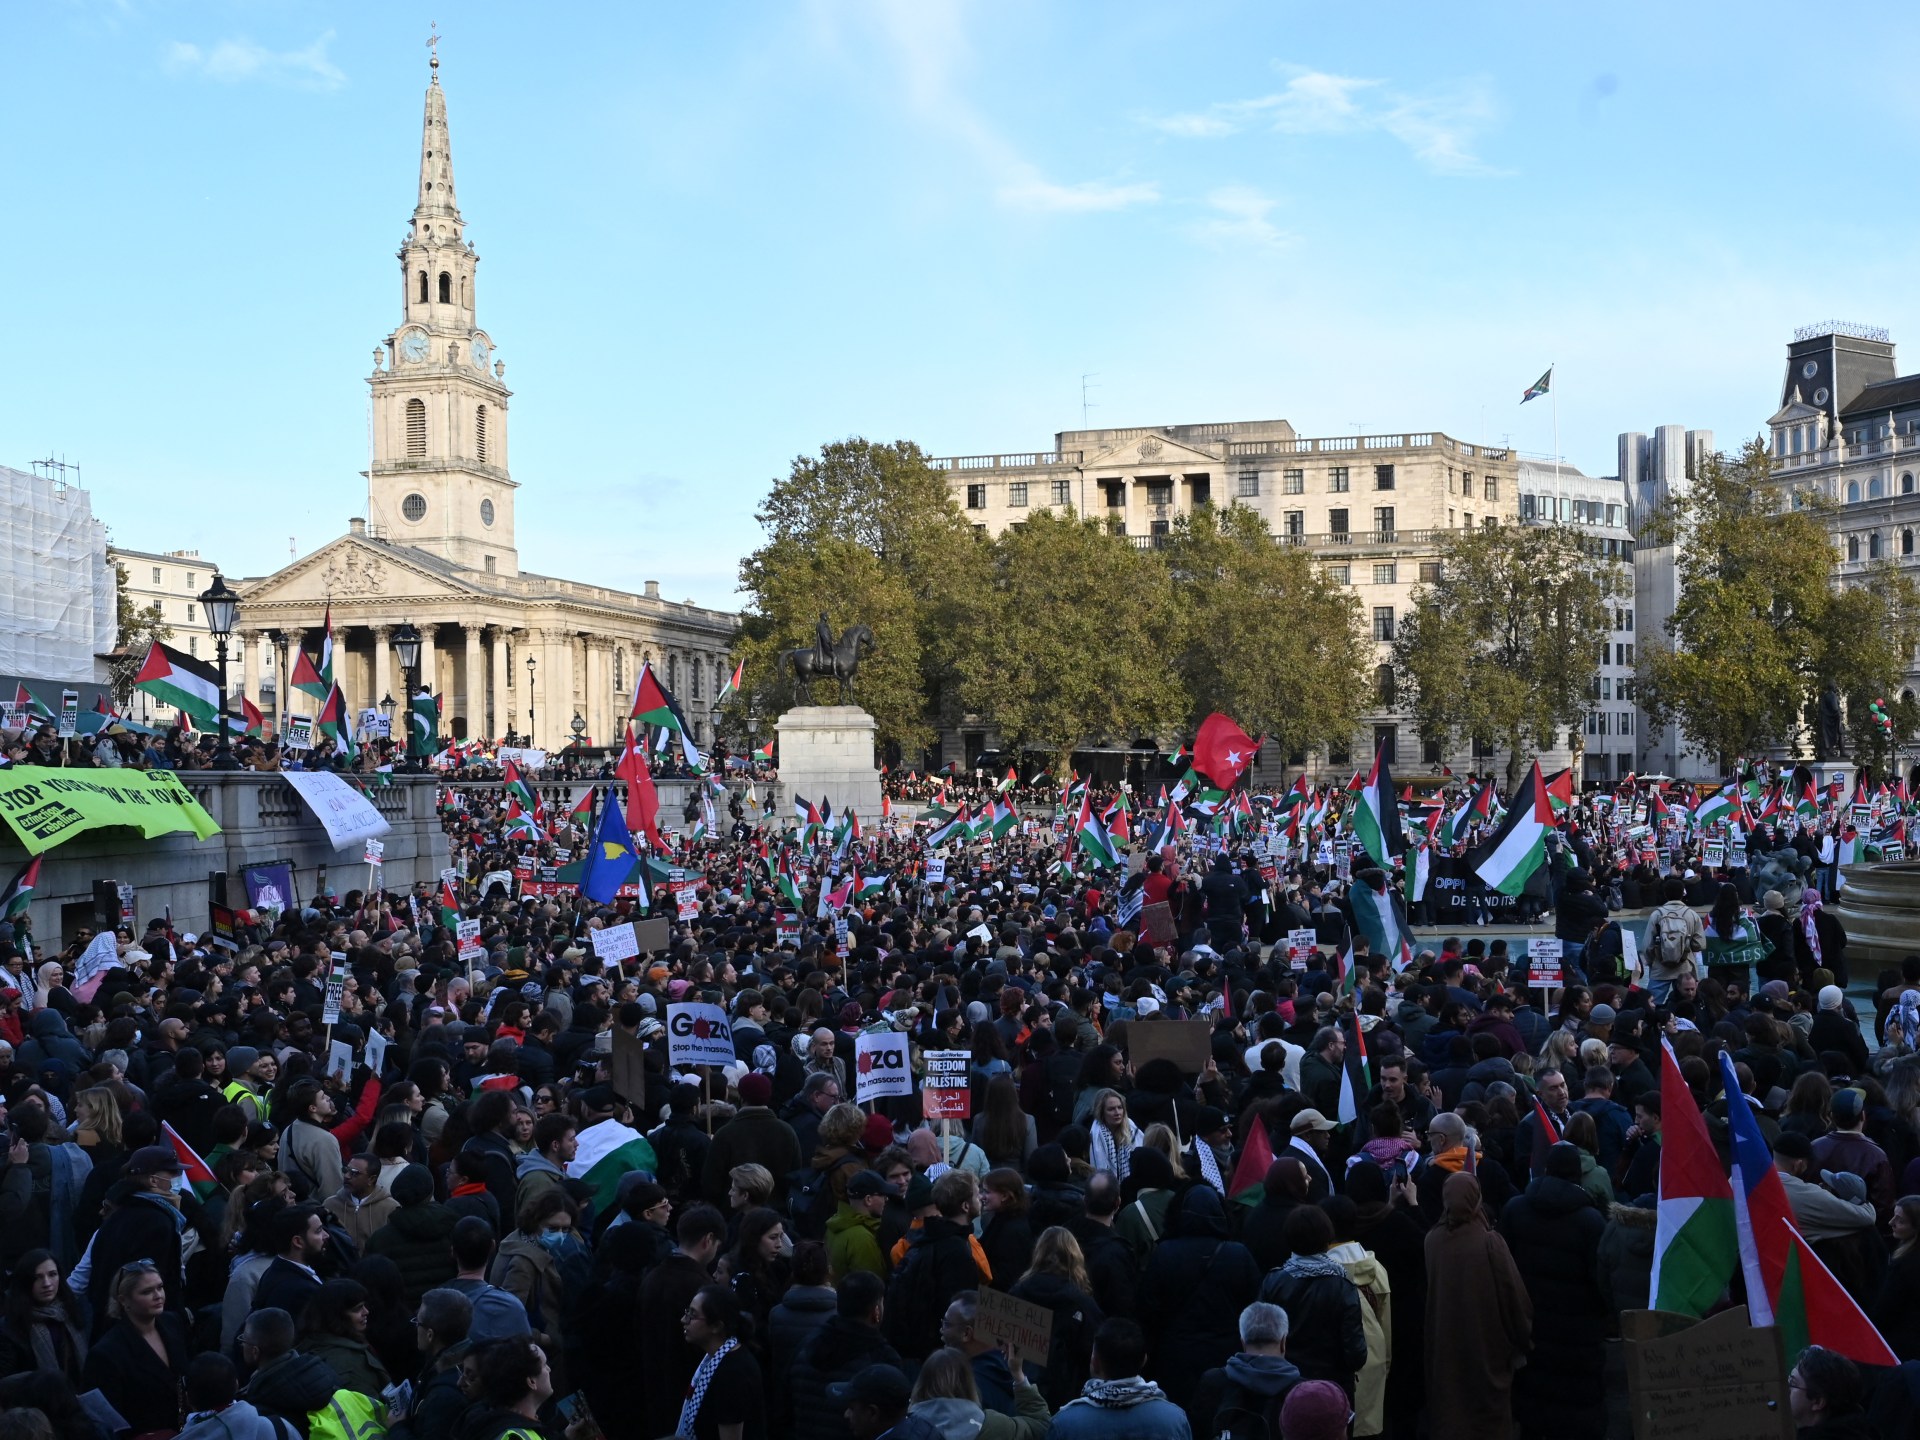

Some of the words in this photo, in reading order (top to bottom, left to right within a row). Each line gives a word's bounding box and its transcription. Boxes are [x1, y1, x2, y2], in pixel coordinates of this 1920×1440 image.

[62, 712, 76, 722] FREE
[290, 728, 311, 738] FREE
[0, 784, 44, 811] STOP
[122, 788, 151, 805] THE
[20, 806, 60, 827] extinction
[42, 811, 84, 834] rebellion
[1884, 854, 1904, 862] FREE
[536, 884, 576, 896] Salist
[604, 928, 617, 937] ONLY
[596, 944, 619, 955] ANOTHER
[621, 940, 635, 949] PIECE
[1707, 947, 1761, 963] PALES
[328, 982, 342, 1000] FREE
[671, 1012, 730, 1042] Gza
[927, 1060, 966, 1071] FREEDOM
[868, 1076, 906, 1087] massacre
[926, 1076, 968, 1088] PALESTINE
[932, 1092, 960, 1103] الحرية
[929, 1103, 964, 1113] لفلسطين
[980, 1288, 995, 1310] WE
[1000, 1297, 1022, 1319] ARE
[1026, 1307, 1046, 1328] ALL
[977, 1312, 1049, 1354] PALESTINIANS
